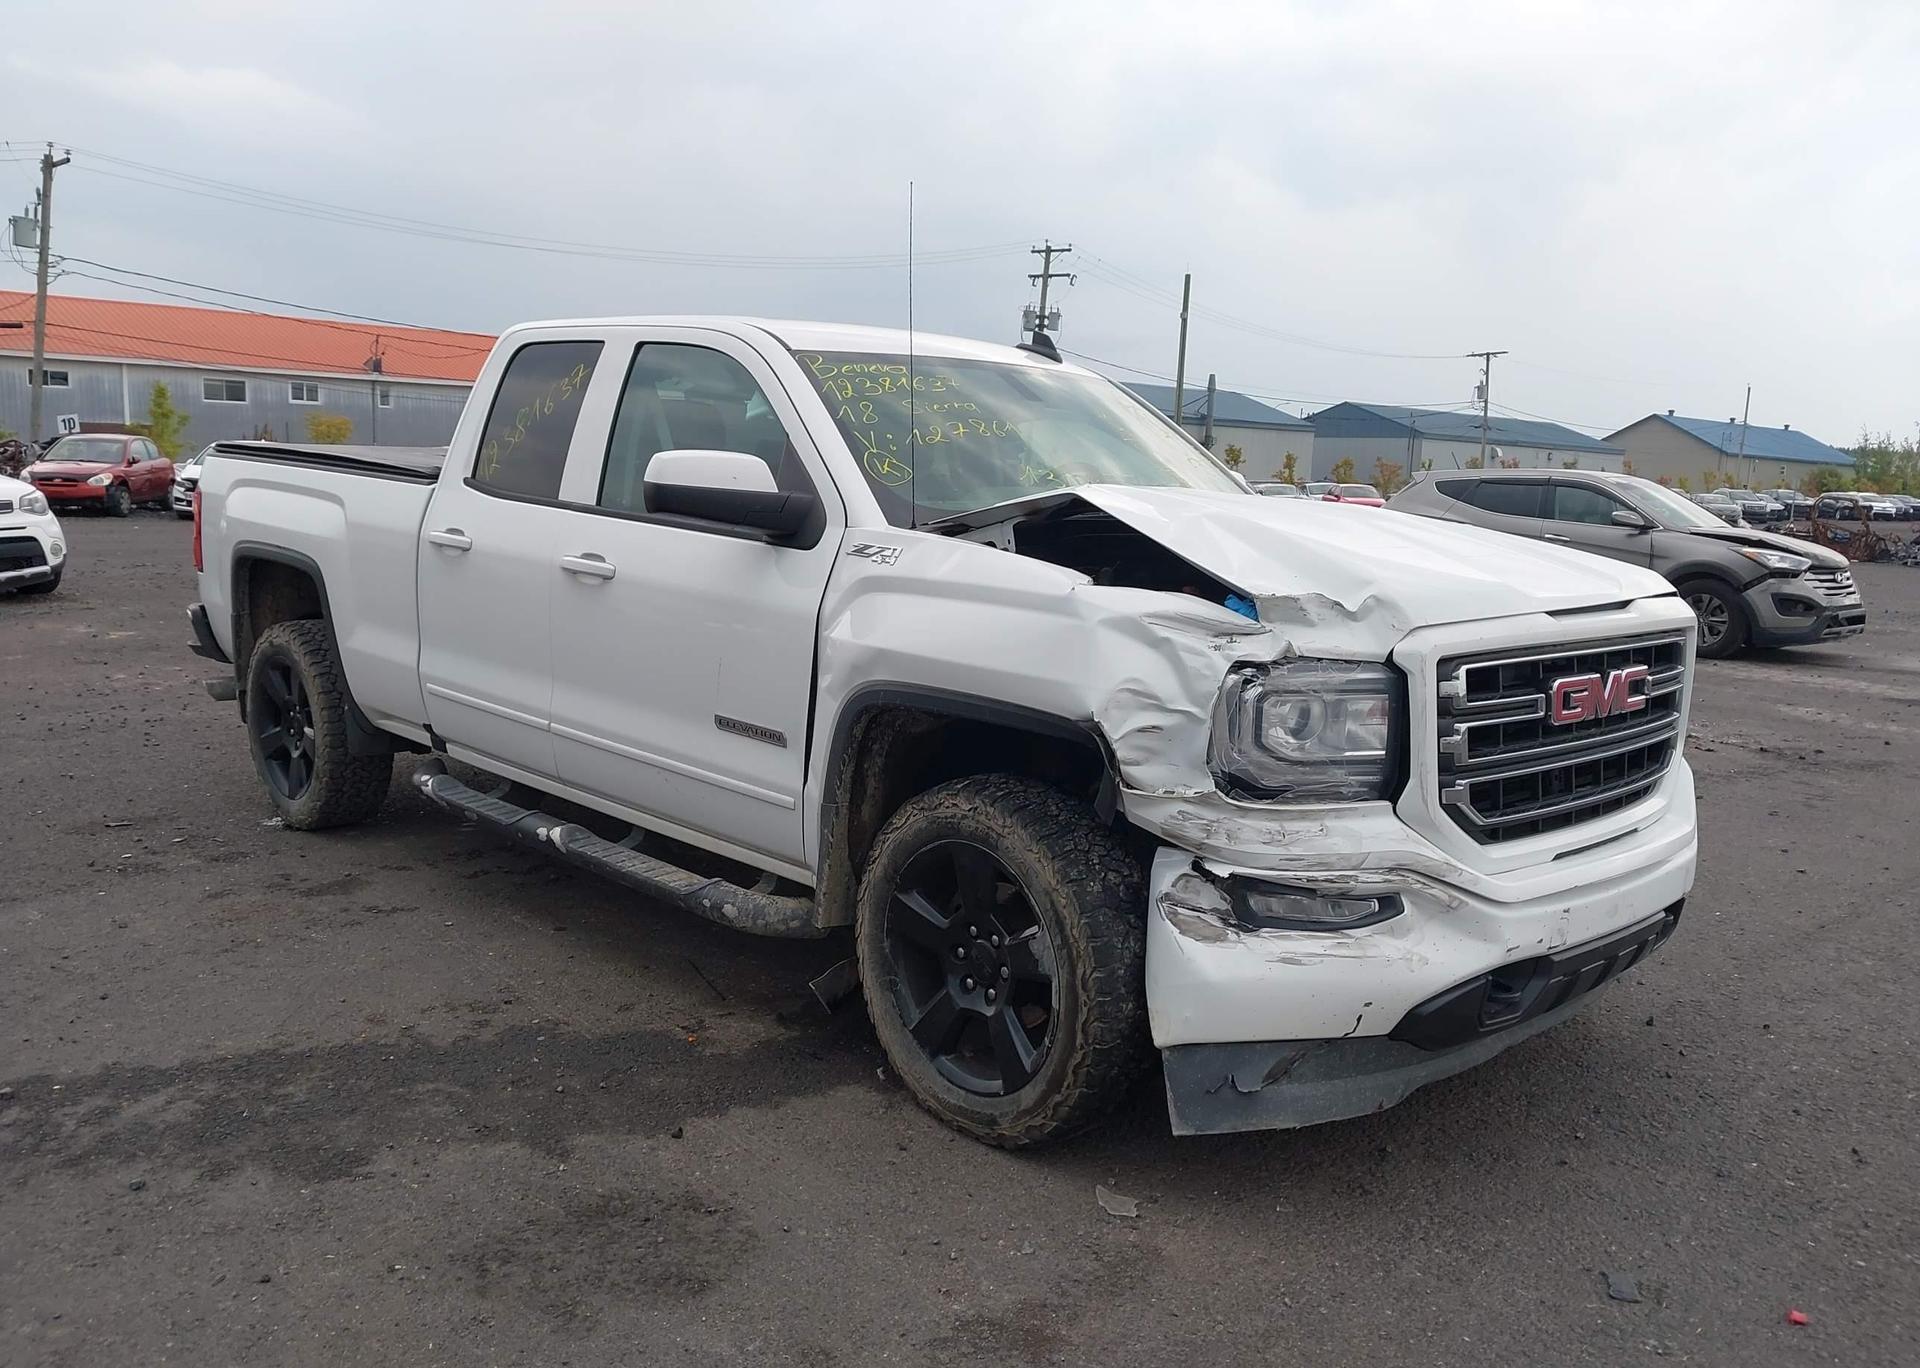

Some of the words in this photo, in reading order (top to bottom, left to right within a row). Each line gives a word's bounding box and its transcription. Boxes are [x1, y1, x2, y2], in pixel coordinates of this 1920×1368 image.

[836, 402, 879, 424] 18
[1552, 665, 1648, 726] GMC
[718, 718, 782, 742] ELEVATION
